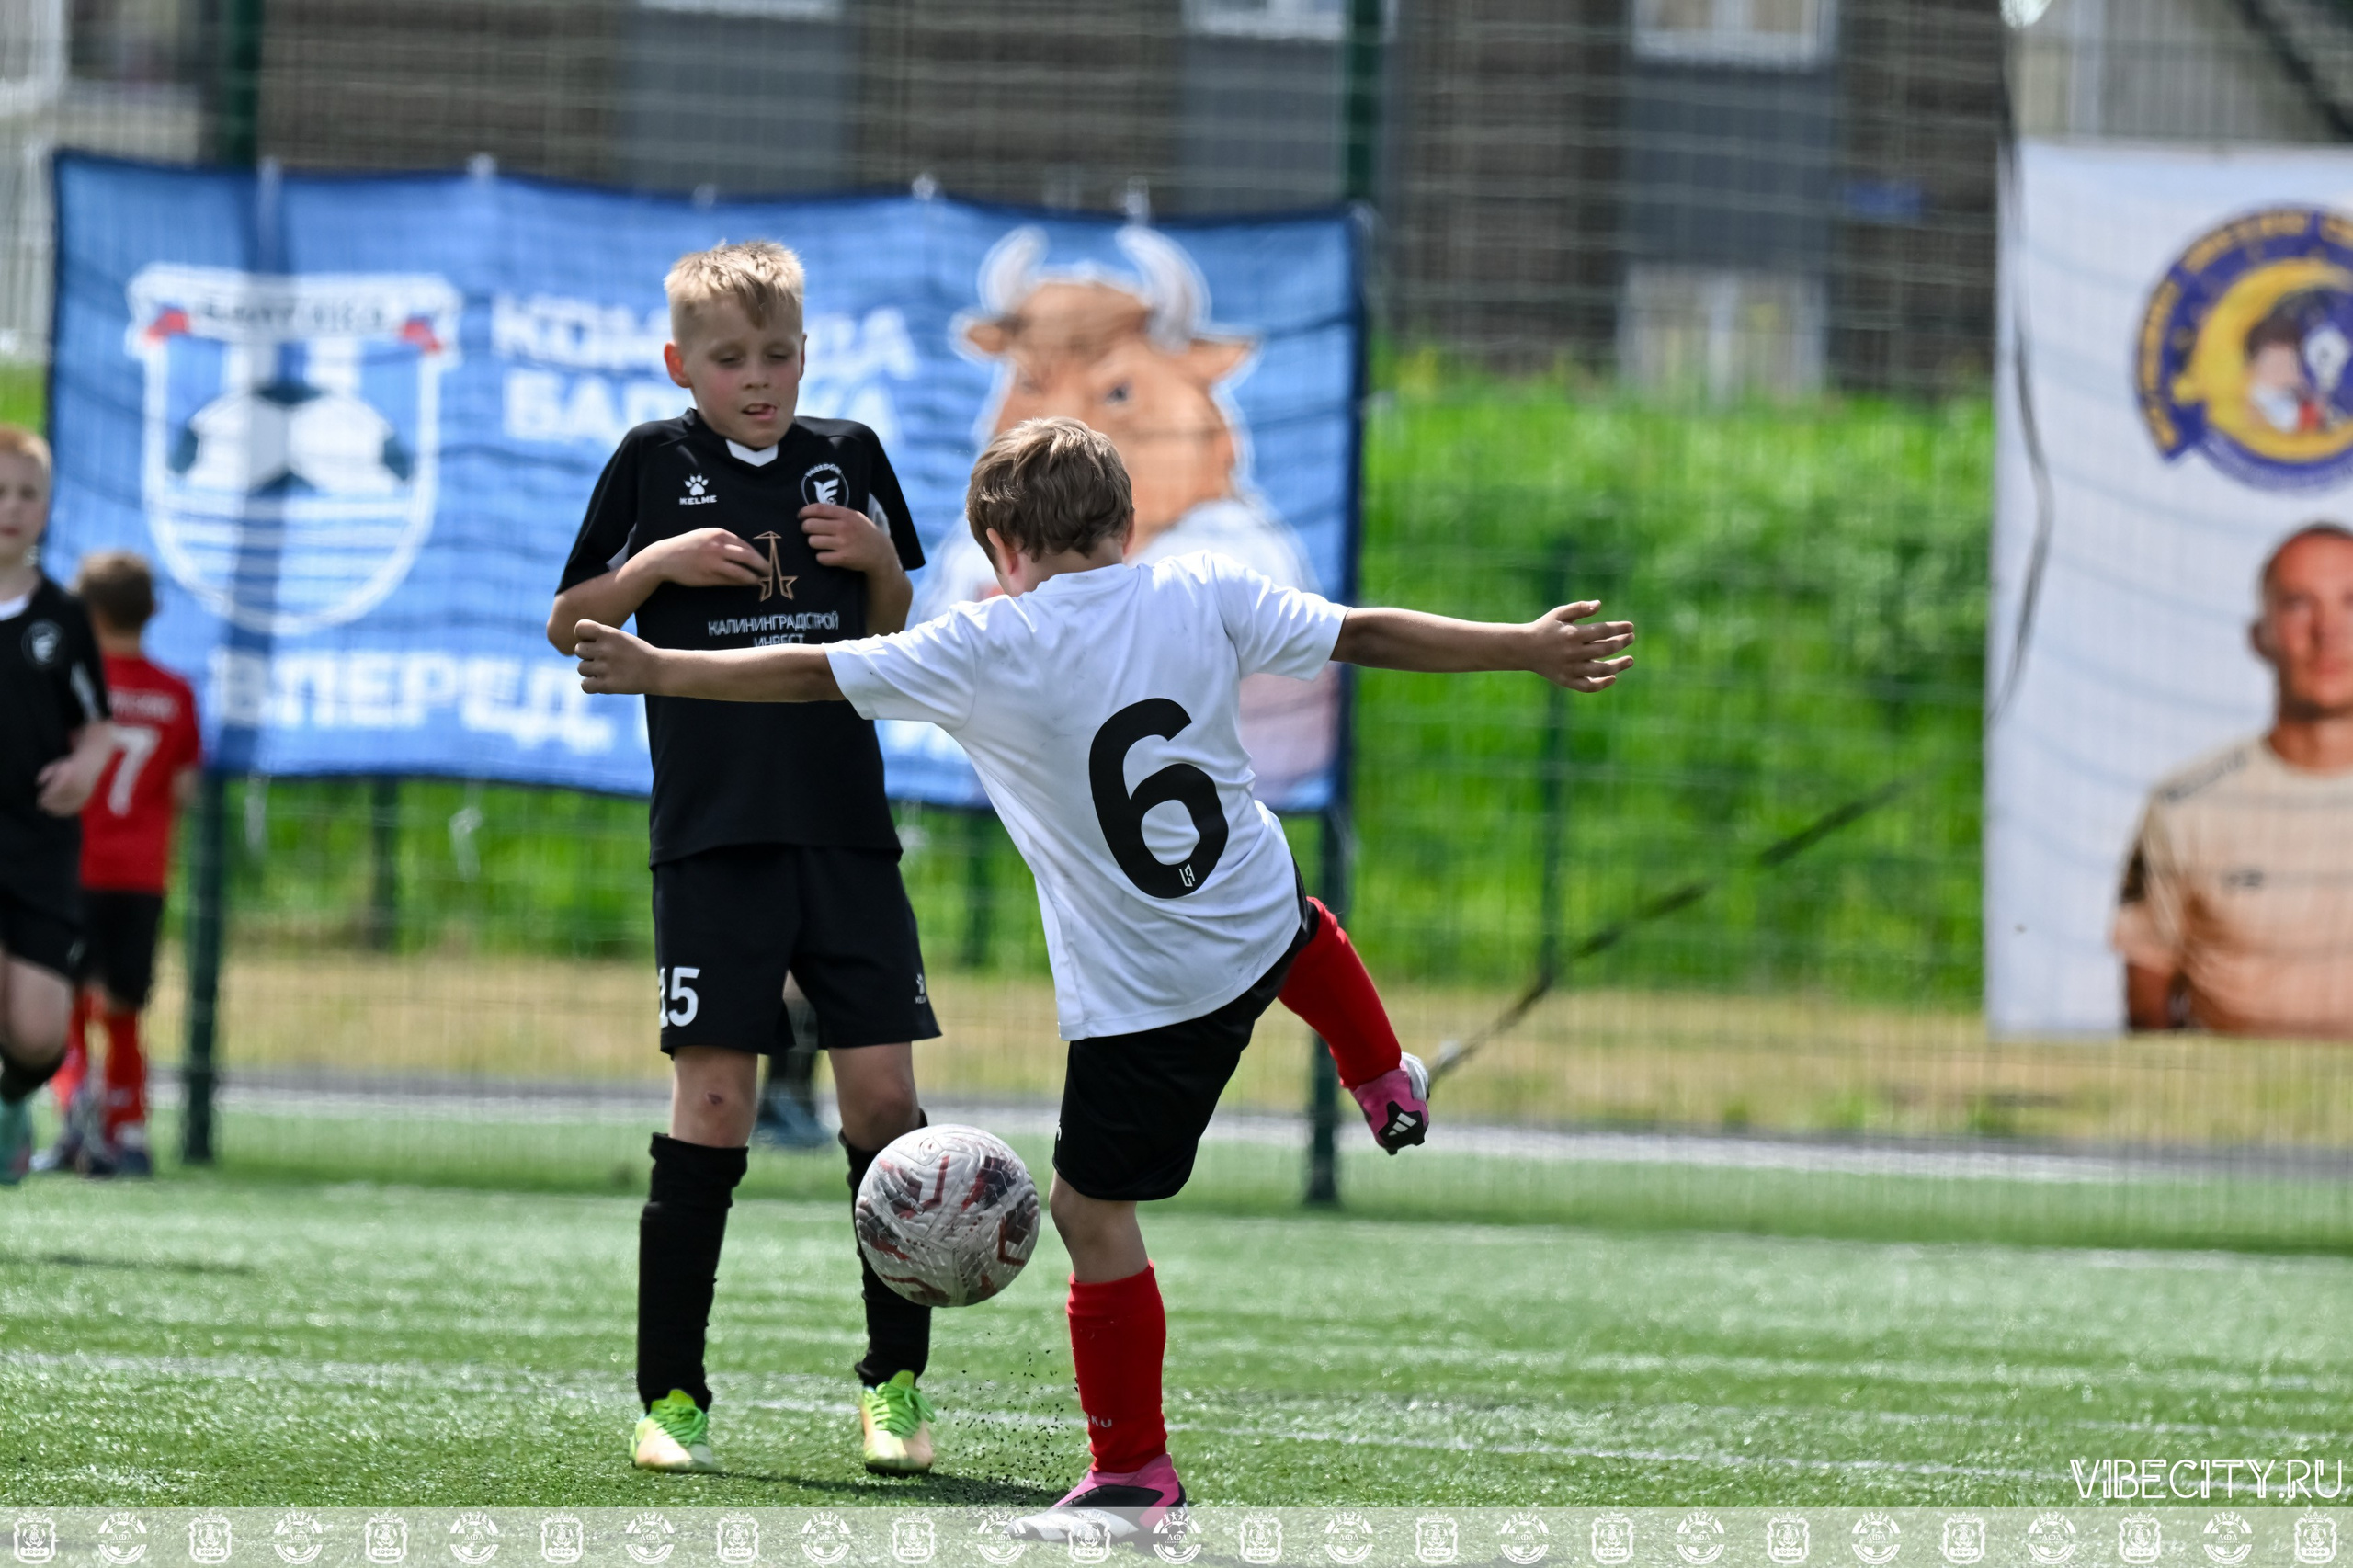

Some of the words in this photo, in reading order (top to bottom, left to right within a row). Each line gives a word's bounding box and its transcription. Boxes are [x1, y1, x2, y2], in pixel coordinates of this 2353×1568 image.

[678, 494, 718, 506] KELME
[708, 610, 839, 637] КАЛИНИНГРАДСТРОЙ
[107, 725, 161, 817] 7
[1088, 696, 1230, 899] 6
[659, 965, 701, 1028] 15
